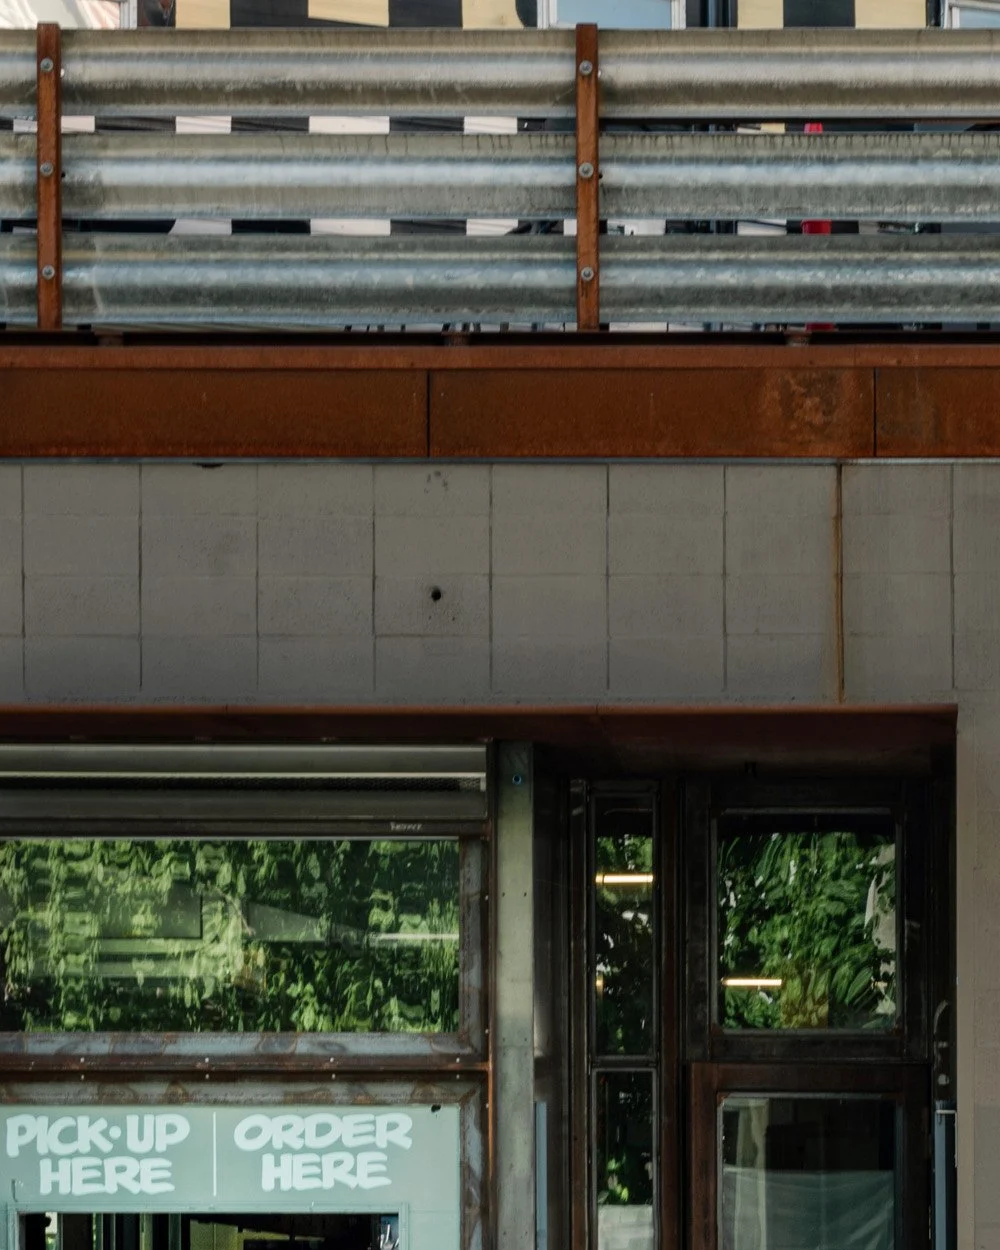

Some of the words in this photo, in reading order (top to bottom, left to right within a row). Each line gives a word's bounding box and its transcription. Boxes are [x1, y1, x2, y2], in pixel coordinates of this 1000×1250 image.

[233, 1112, 413, 1151] ORDER
[39, 1156, 176, 1196] HERE
[261, 1151, 392, 1191] HERE
